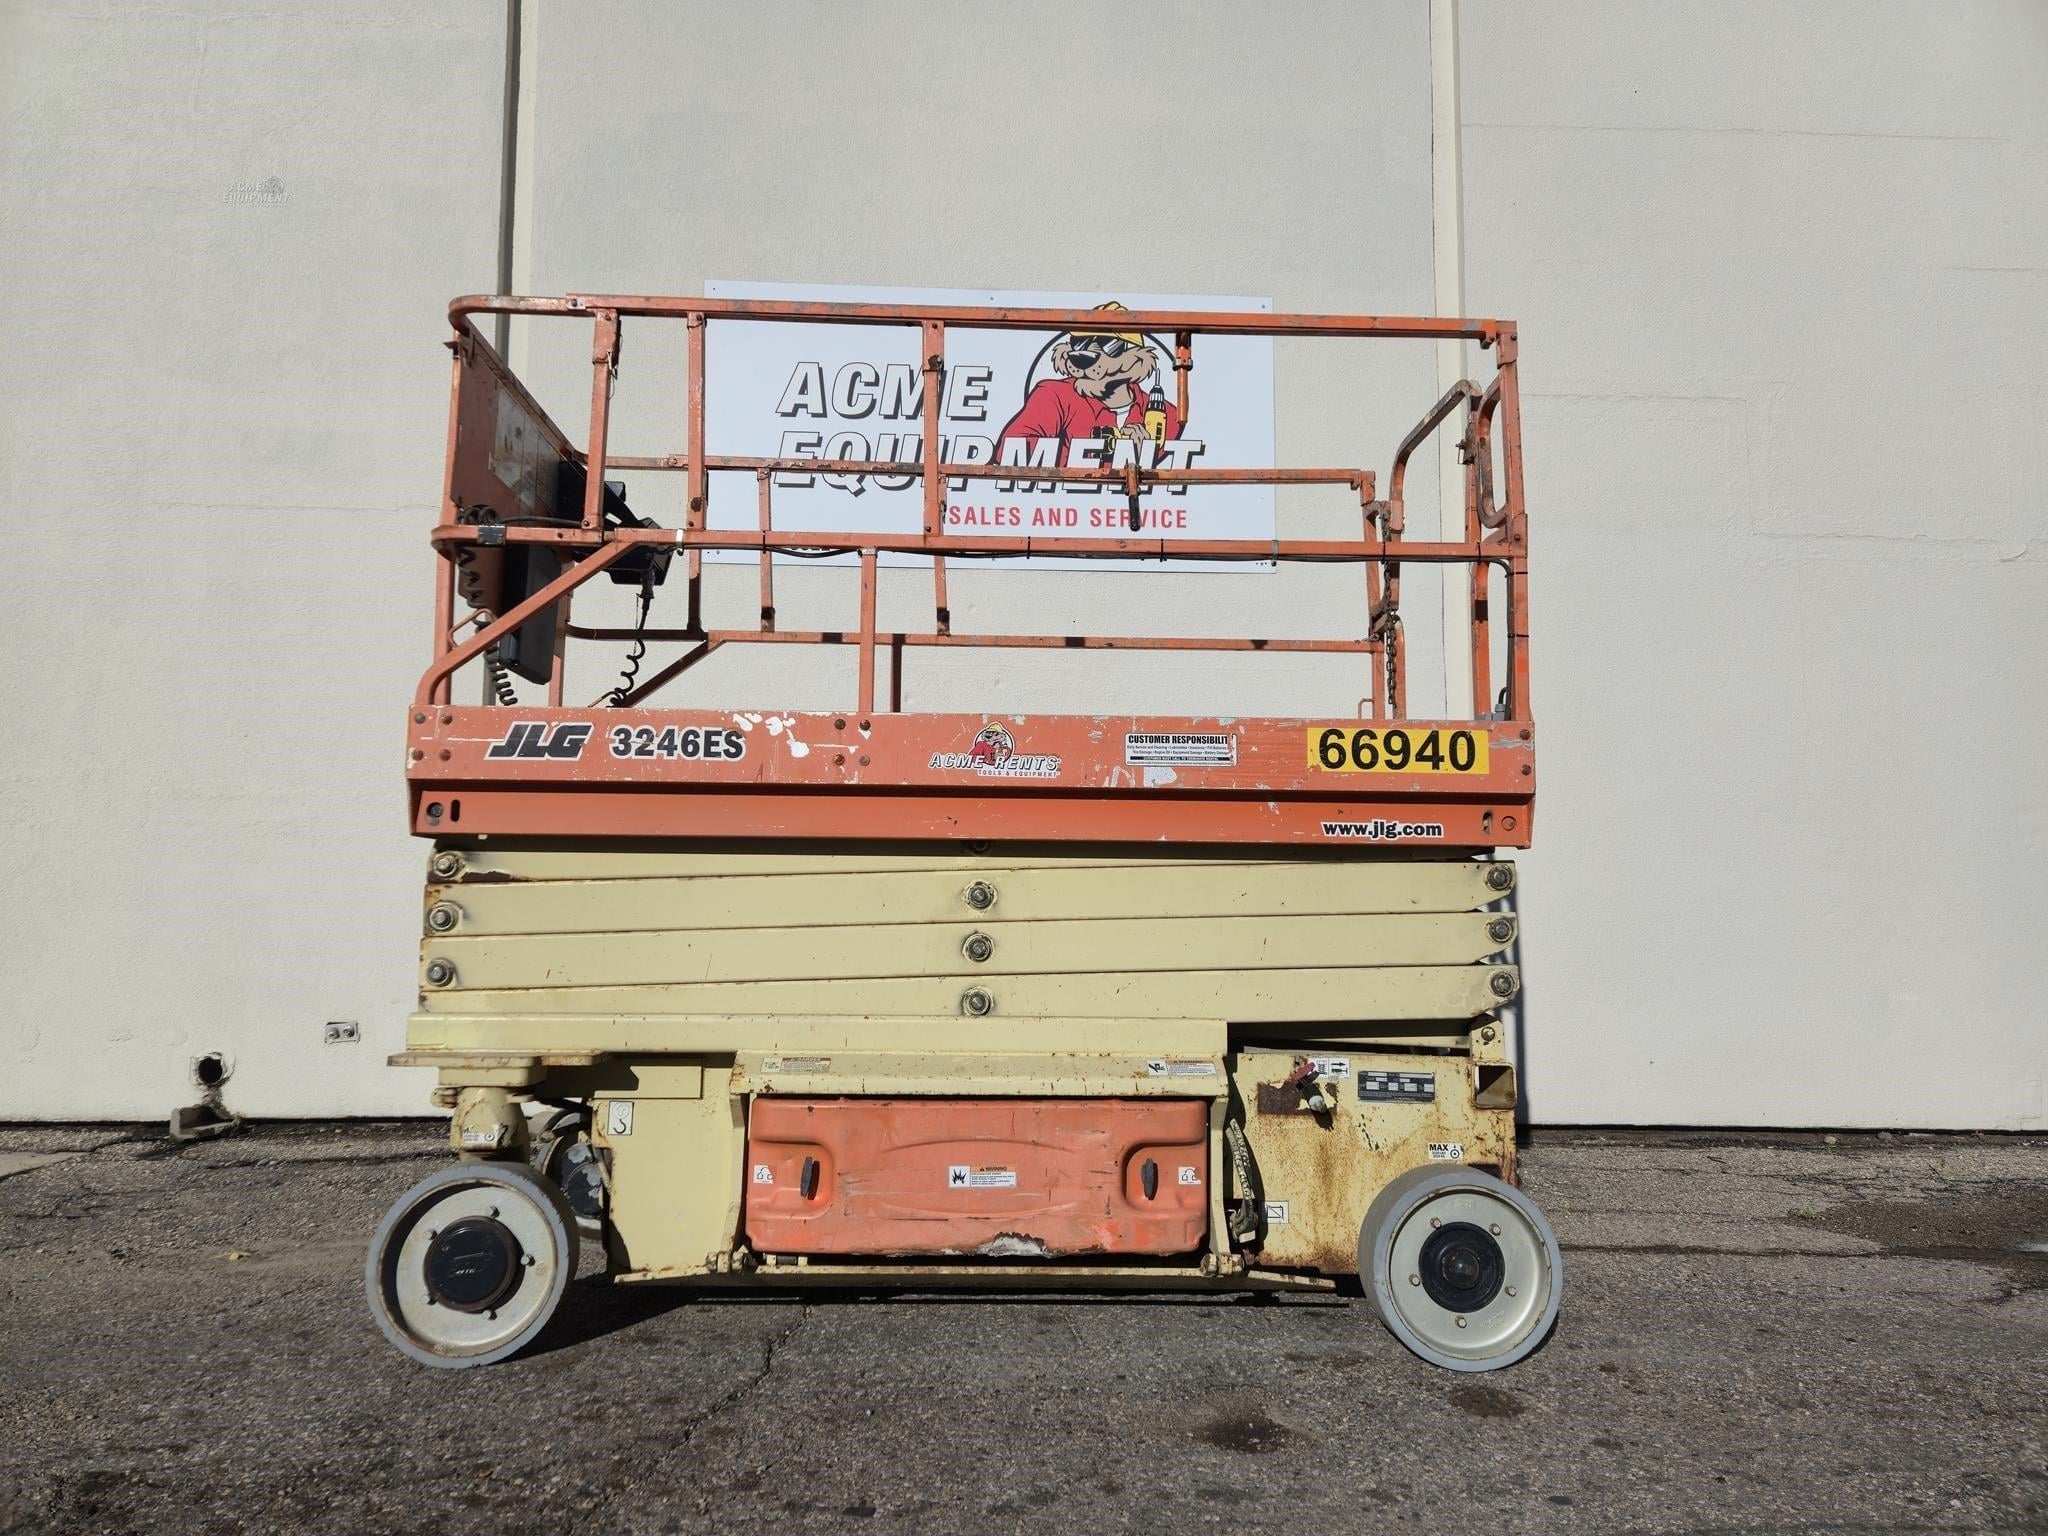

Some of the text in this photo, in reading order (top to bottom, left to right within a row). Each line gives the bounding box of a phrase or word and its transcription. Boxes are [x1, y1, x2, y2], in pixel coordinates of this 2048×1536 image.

[775, 361, 993, 421] ACME
[949, 506, 1187, 529] SALES AND SERVICE
[486, 722, 744, 760] JLG 3246ES
[1128, 735, 1229, 745] CUSTOMER RESPONSIBILIT
[1318, 728, 1477, 772] 66940
[929, 753, 1058, 771] ACME RENTS
[1323, 821, 1443, 839] www.jlg.com
[1429, 1143, 1449, 1151] MAX
